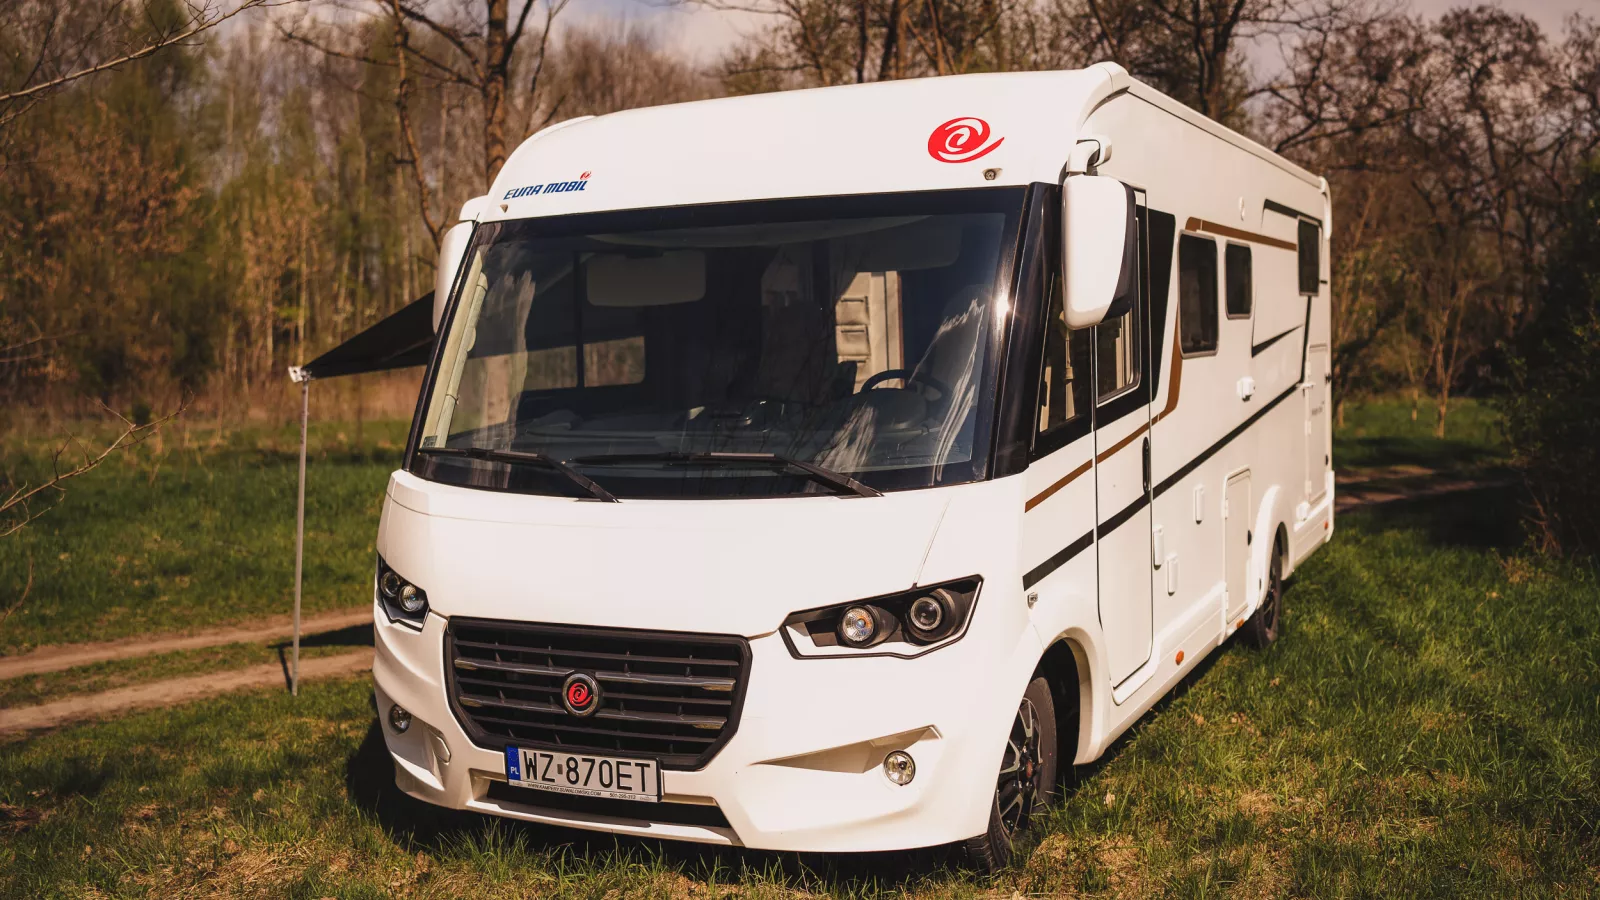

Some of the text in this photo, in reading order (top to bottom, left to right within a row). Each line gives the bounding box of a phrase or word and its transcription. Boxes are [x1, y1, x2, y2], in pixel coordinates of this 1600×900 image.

[503, 180, 588, 200] EURA MOBIL
[510, 766, 519, 775] PL
